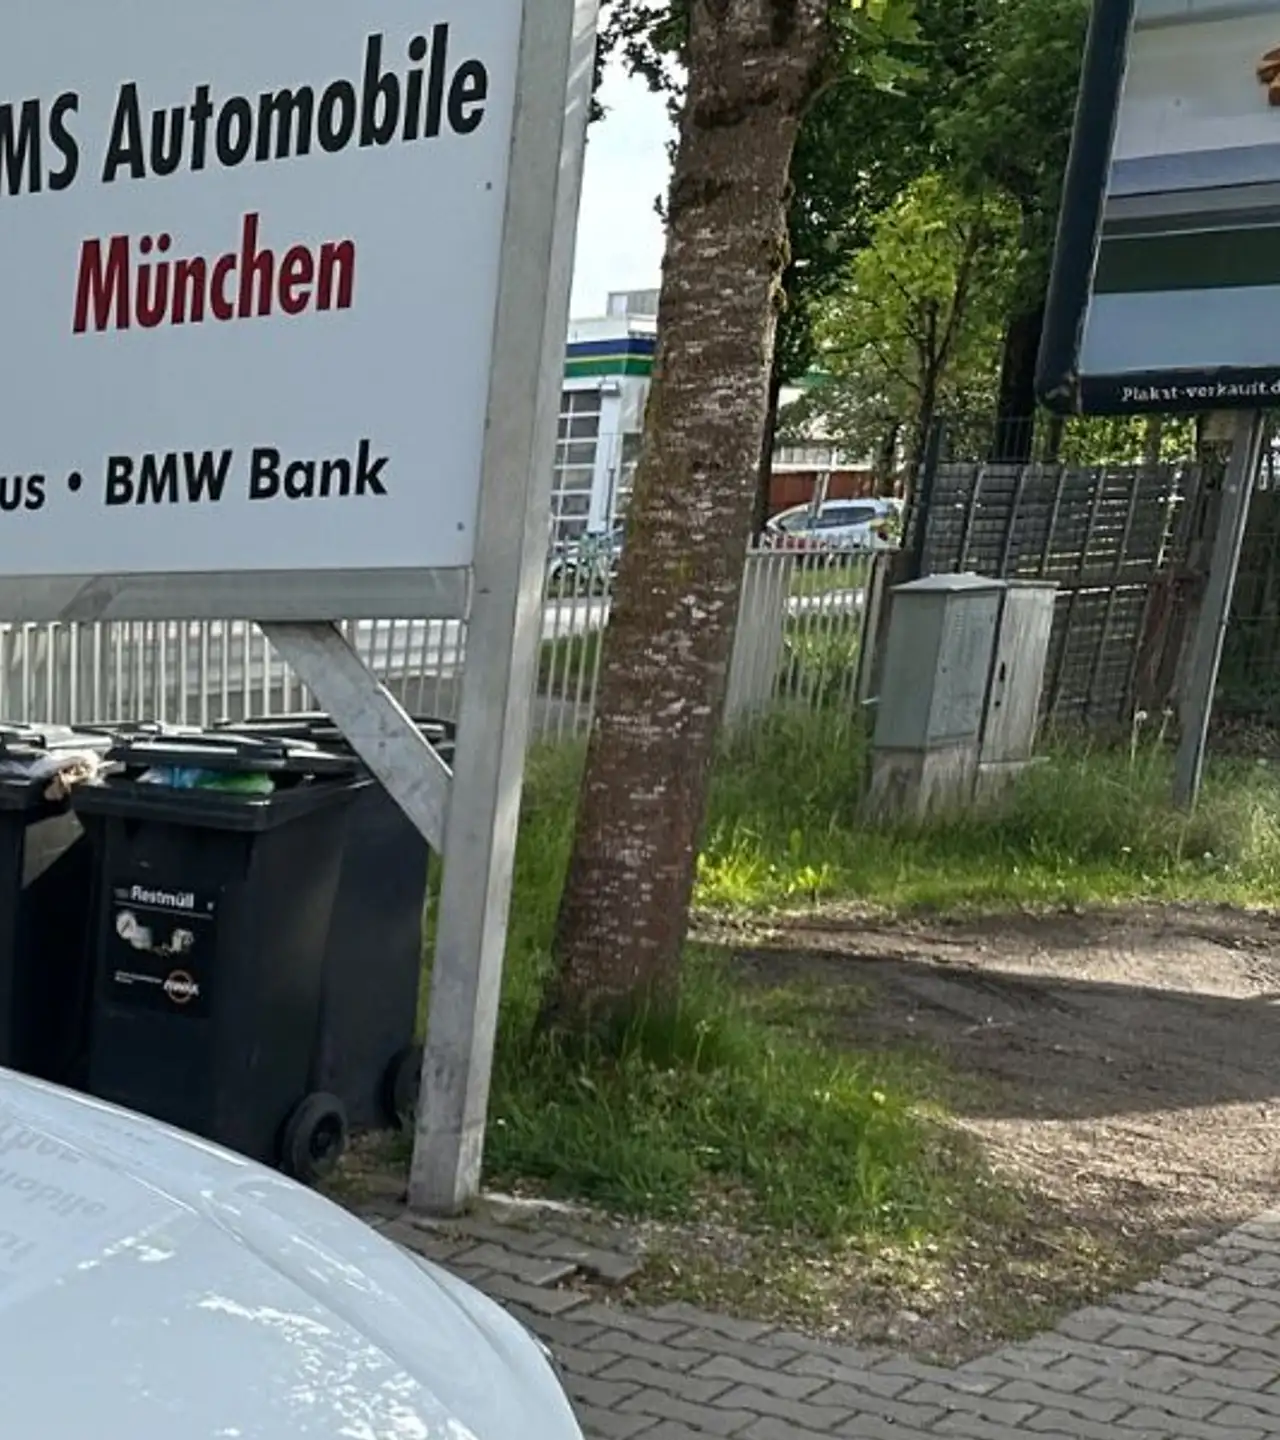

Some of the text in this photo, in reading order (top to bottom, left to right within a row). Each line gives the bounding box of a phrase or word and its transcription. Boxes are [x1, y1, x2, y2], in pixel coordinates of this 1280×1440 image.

[102, 23, 489, 183] Automobile
[73, 213, 355, 333] München
[105, 449, 233, 505] BMW
[248, 439, 389, 500] Bank
